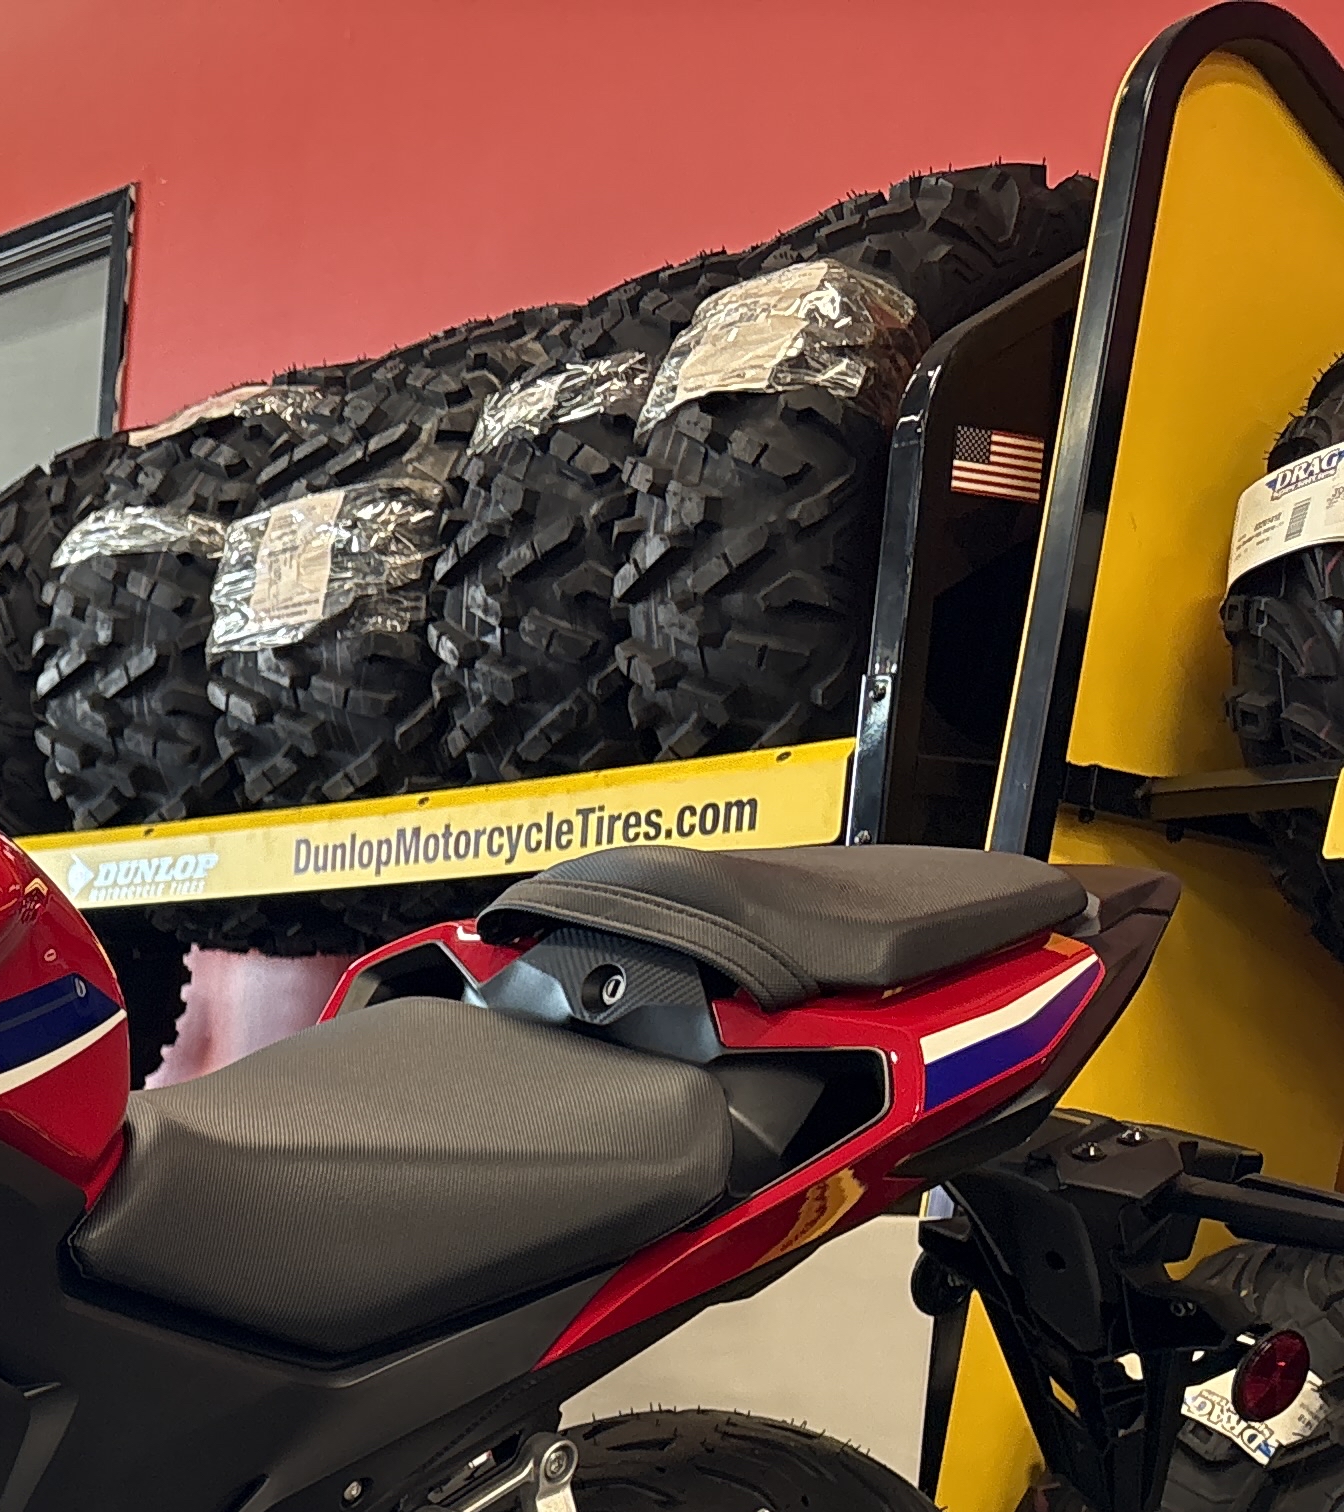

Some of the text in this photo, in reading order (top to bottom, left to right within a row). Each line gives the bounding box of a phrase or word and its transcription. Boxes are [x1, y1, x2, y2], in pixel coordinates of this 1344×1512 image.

[1275, 448, 1340, 492] DRAG
[293, 797, 758, 876] DunlopMotorcycleTires.com
[93, 852, 219, 888] DUNLOP
